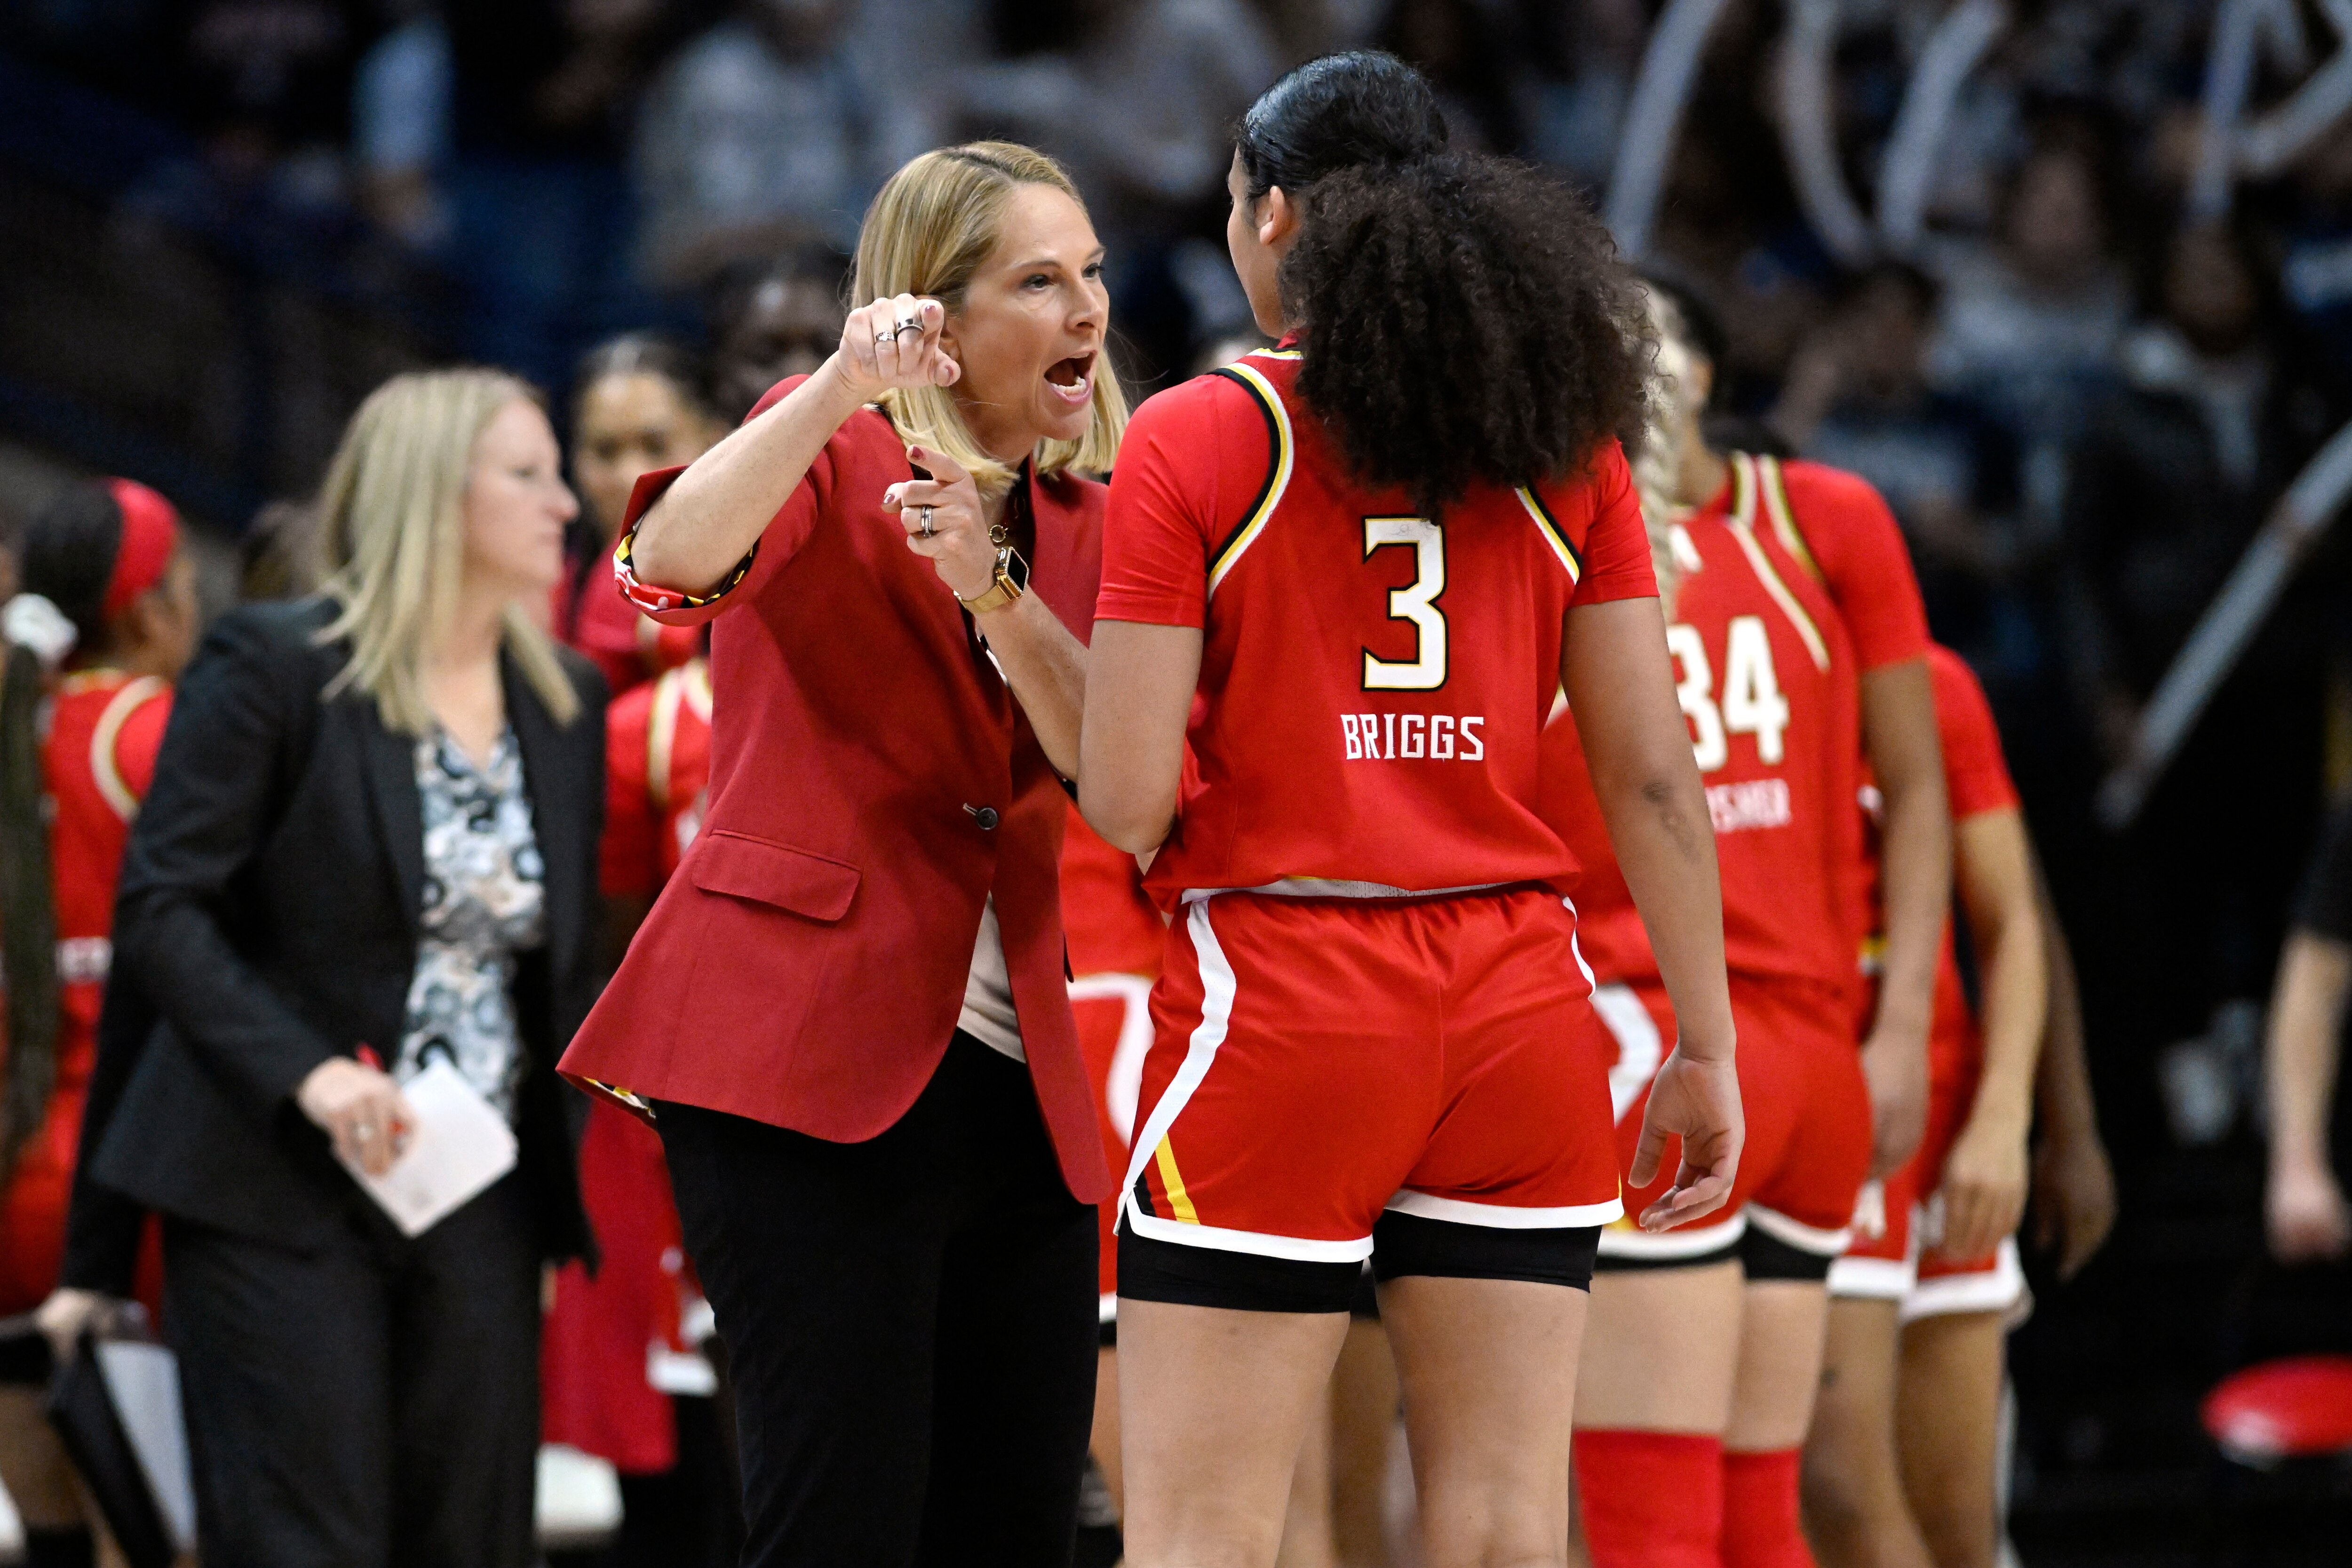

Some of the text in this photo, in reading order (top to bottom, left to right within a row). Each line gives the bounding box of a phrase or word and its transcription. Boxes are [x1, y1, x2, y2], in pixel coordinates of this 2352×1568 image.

[1362, 516, 1449, 691] 3
[1340, 713, 1484, 760] BRIGGS
[1666, 614, 1789, 772] 34
